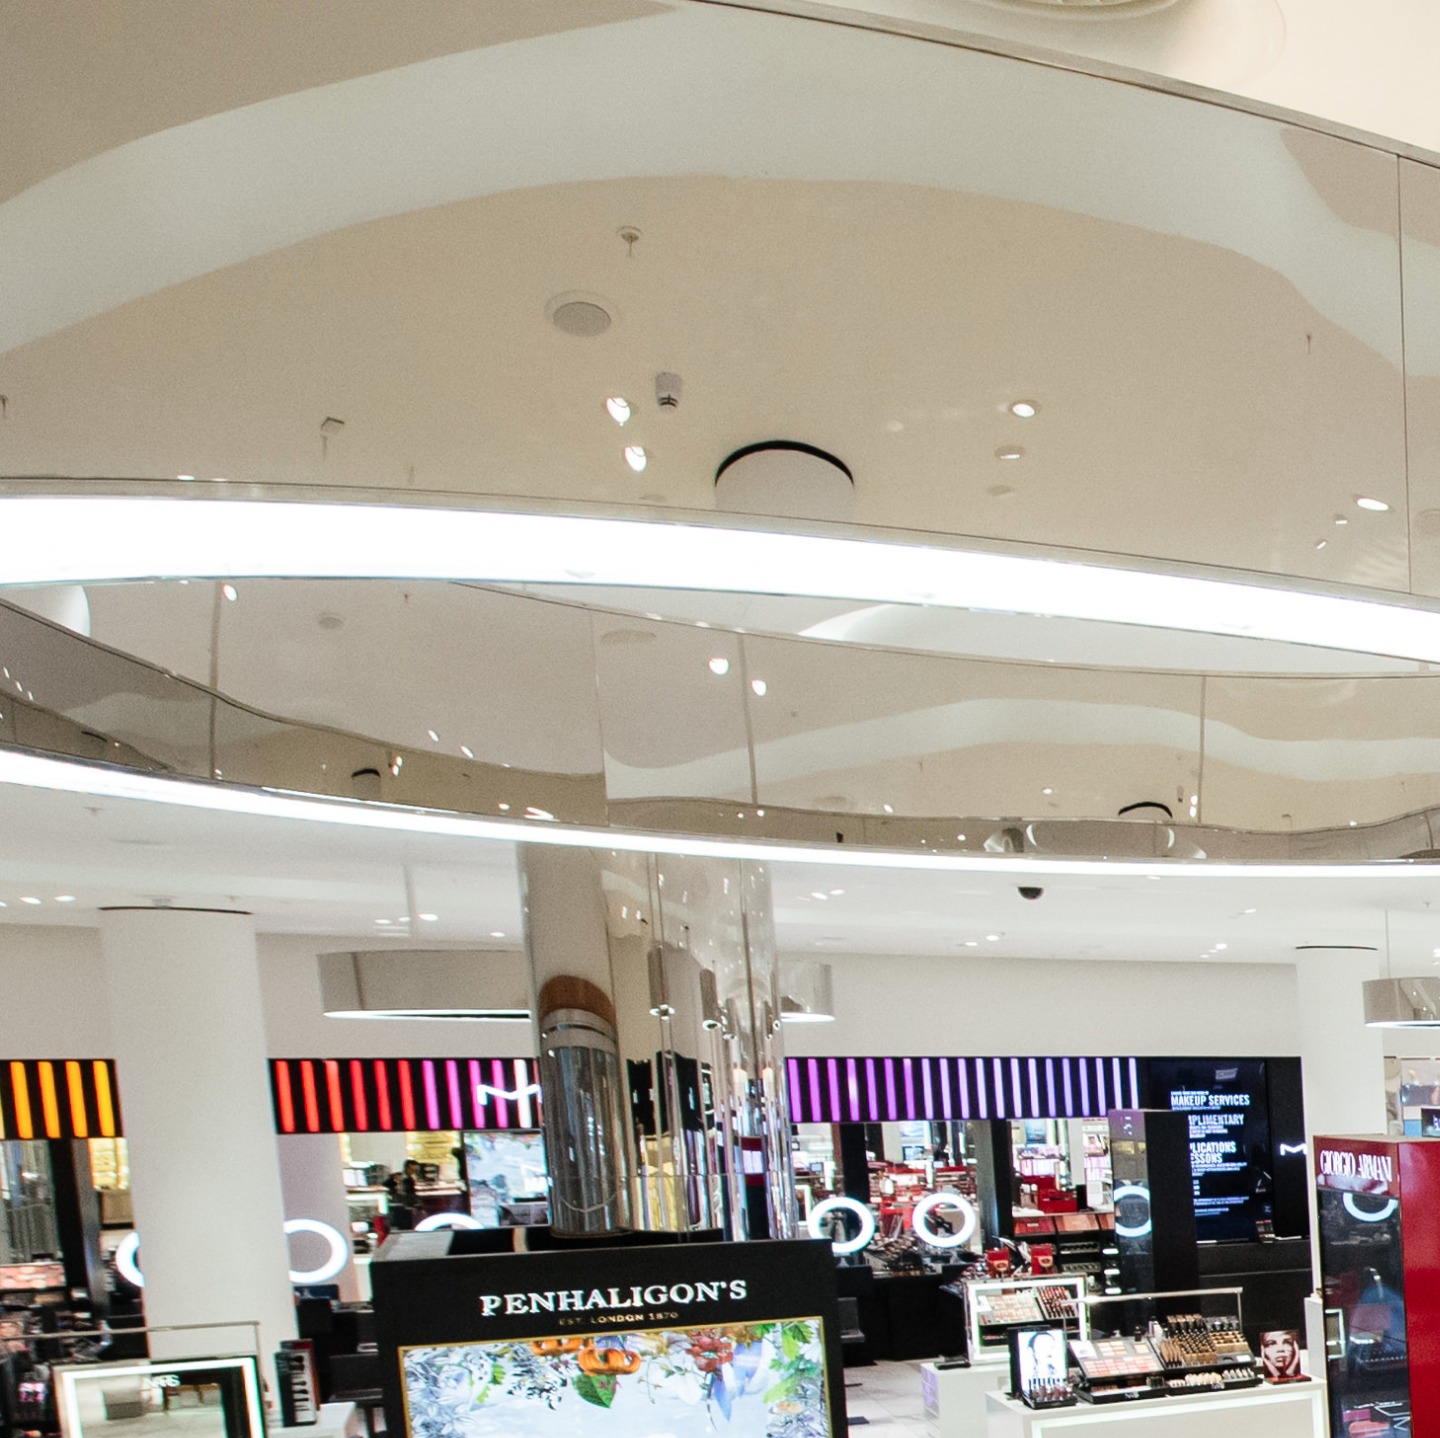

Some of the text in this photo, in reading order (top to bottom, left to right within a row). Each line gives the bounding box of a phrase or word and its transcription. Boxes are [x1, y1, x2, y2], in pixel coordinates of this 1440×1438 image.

[1171, 1094, 1250, 1106] MAKEUP SERVICES
[1320, 1150, 1392, 1182] GIORGIO ARMANI
[479, 1279, 747, 1316] PENHALIGON'S
[590, 1313, 644, 1325] LONDON
